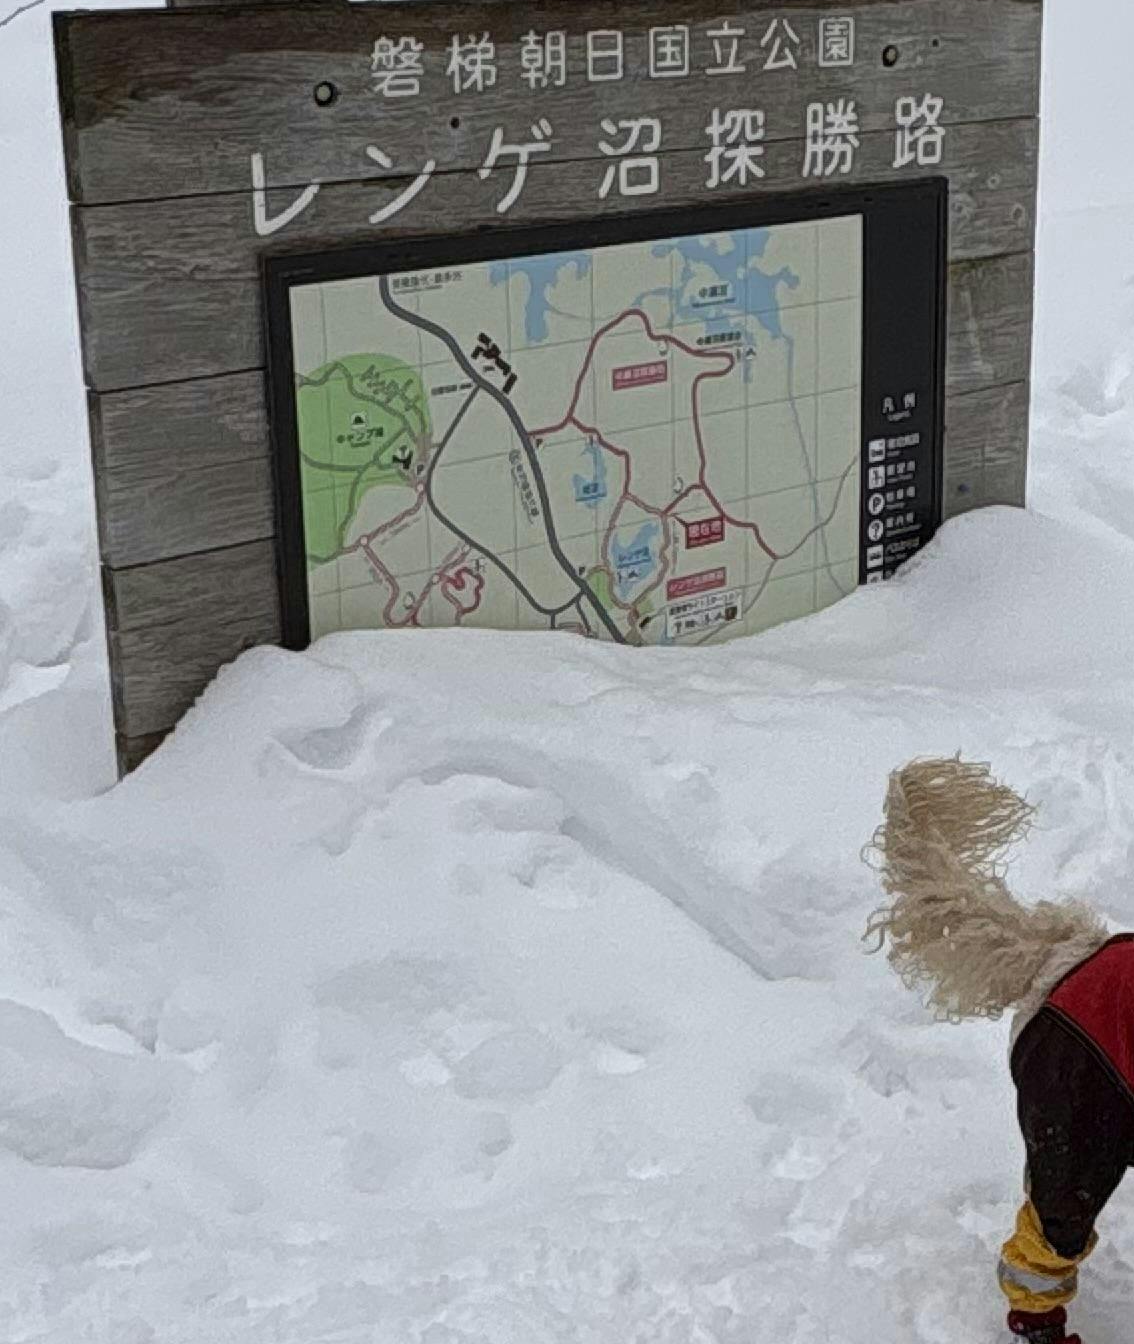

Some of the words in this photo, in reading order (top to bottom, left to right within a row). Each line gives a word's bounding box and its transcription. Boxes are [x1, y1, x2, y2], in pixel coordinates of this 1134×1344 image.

[370, 15, 855, 98] 磐梯朝日国立公園
[250, 92, 947, 237] レンゲ沼探勝路
